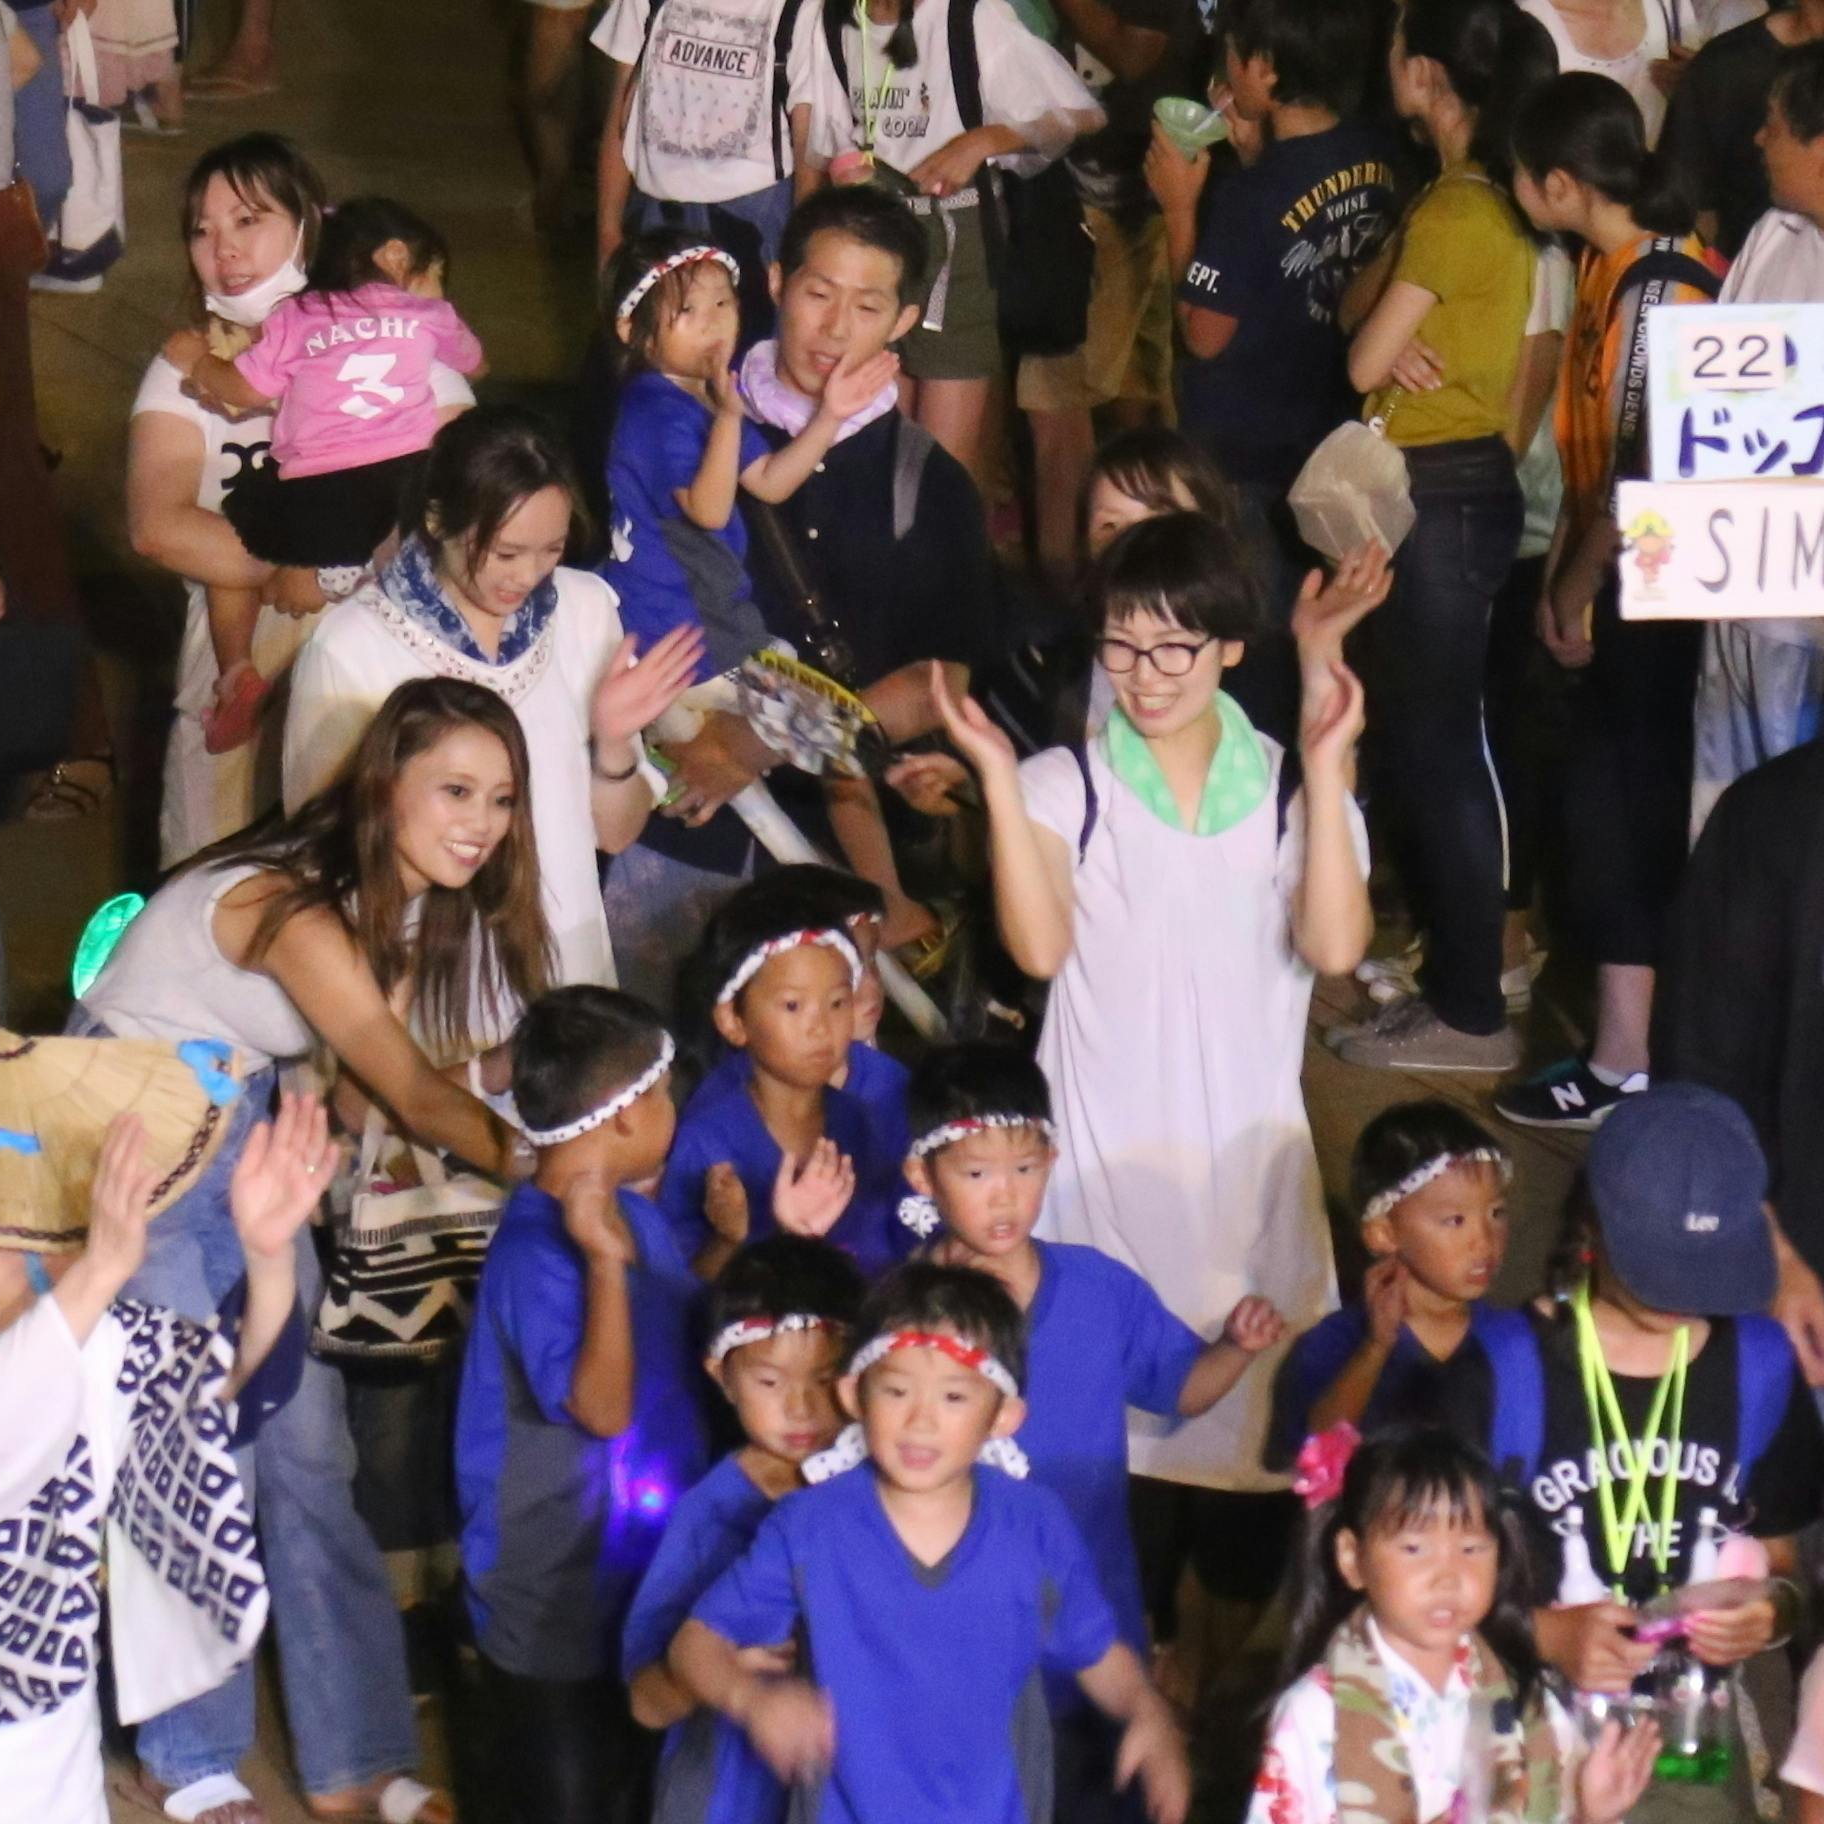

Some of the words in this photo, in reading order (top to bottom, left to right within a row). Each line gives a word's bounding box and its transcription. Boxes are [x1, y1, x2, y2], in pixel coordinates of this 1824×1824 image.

[669, 38, 752, 77] ADVANCE
[1326, 192, 1369, 223] NOISE
[1187, 261, 1221, 294] EPT.
[304, 316, 418, 359] NACHI
[1691, 334, 1774, 380] 22
[336, 352, 405, 421] 3
[1532, 1437, 1721, 1512] GRACIOUS
